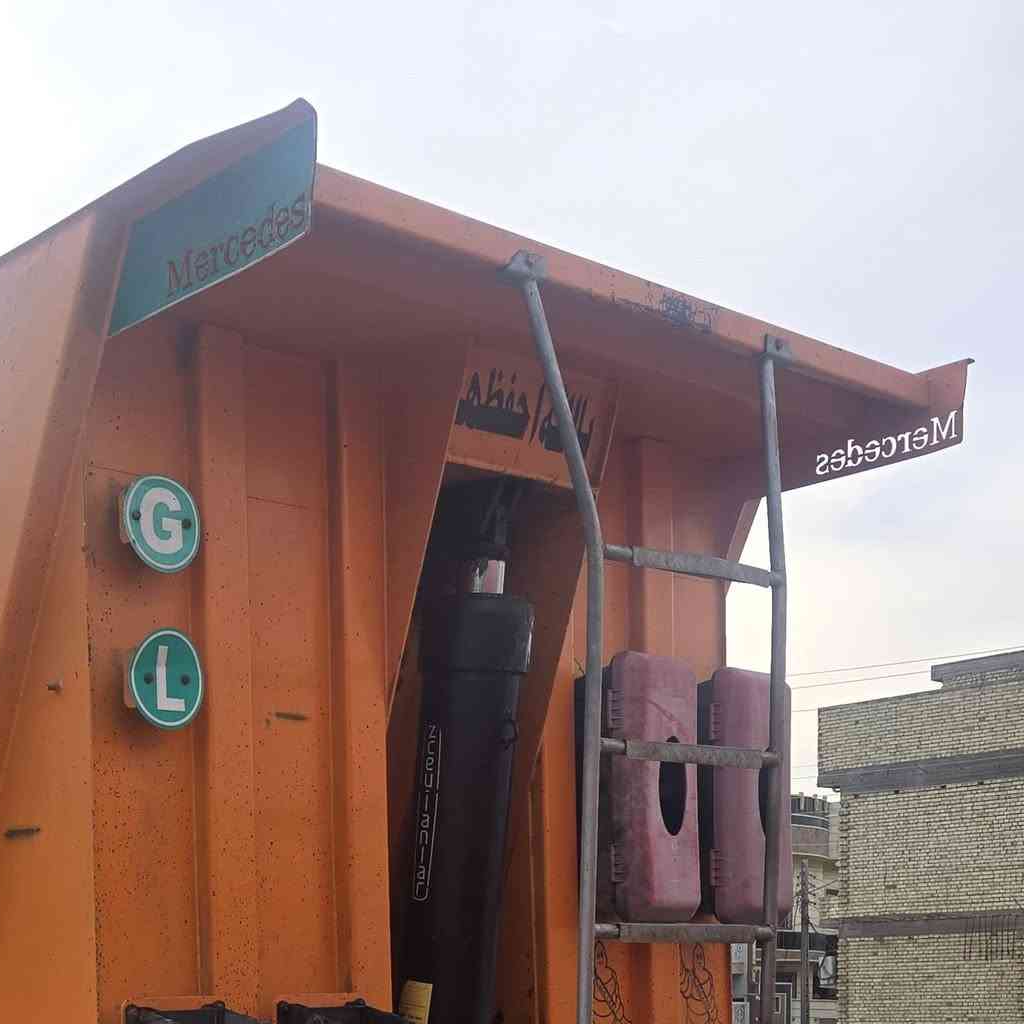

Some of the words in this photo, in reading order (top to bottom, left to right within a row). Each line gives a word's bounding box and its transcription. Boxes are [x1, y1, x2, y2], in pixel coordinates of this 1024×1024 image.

[167, 195, 306, 290] Mercedes
[139, 487, 184, 554] G
[156, 645, 186, 712] L
